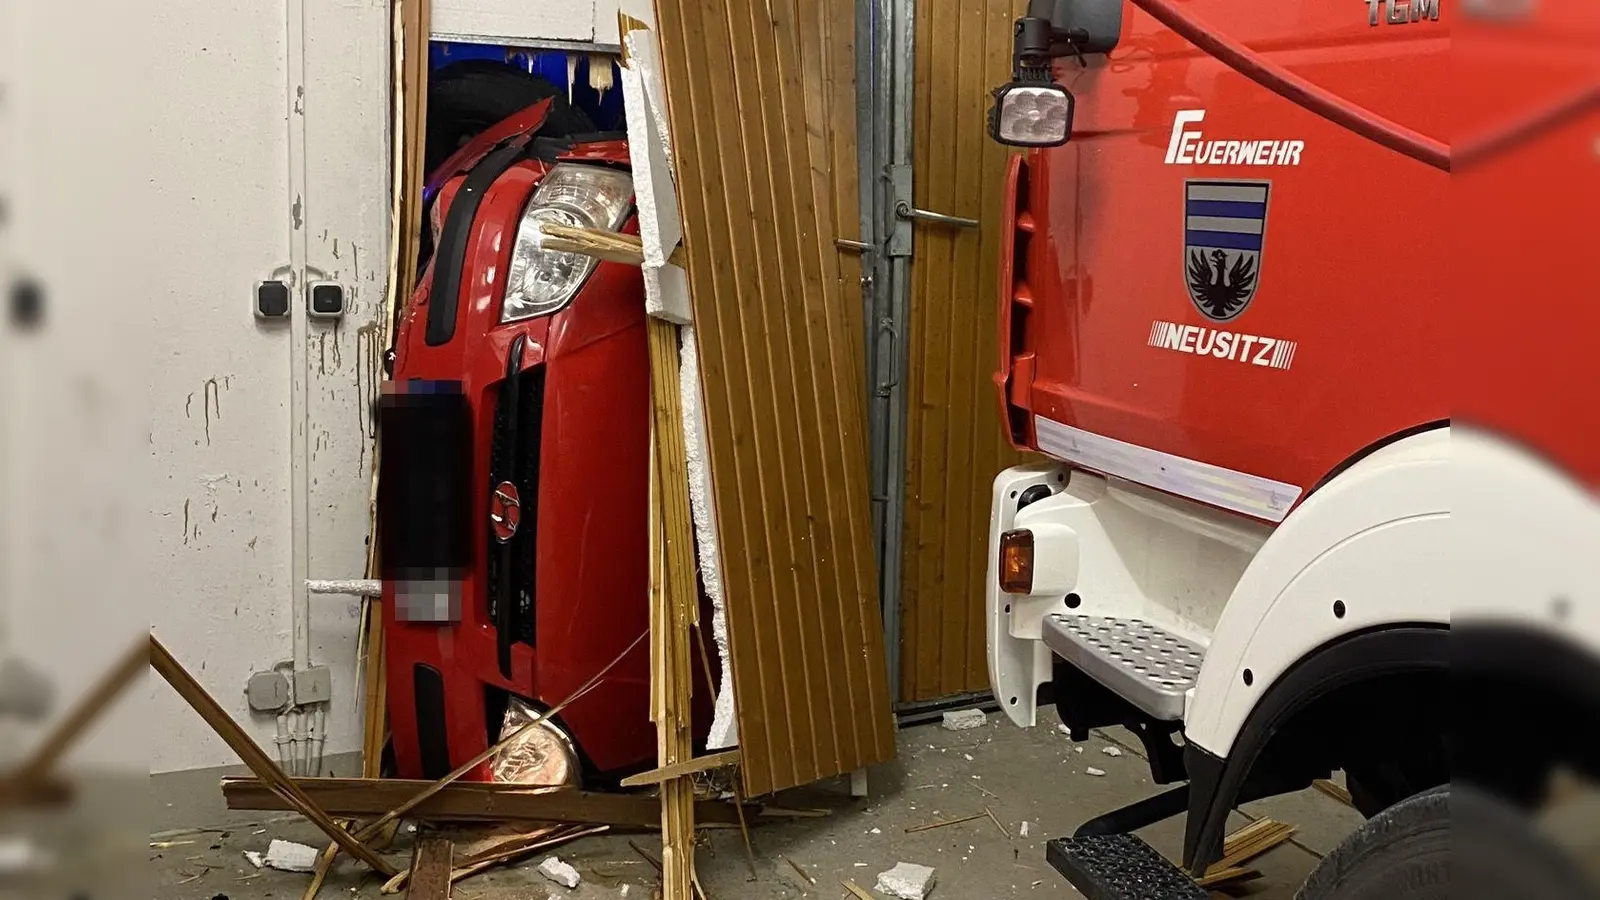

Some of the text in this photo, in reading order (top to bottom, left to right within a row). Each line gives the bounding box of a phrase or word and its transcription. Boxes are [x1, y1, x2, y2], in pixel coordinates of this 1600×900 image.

[1365, 0, 1439, 25] TGM
[1164, 109, 1304, 165] FEUERWEHR
[1164, 321, 1277, 367] NEUSITZ
